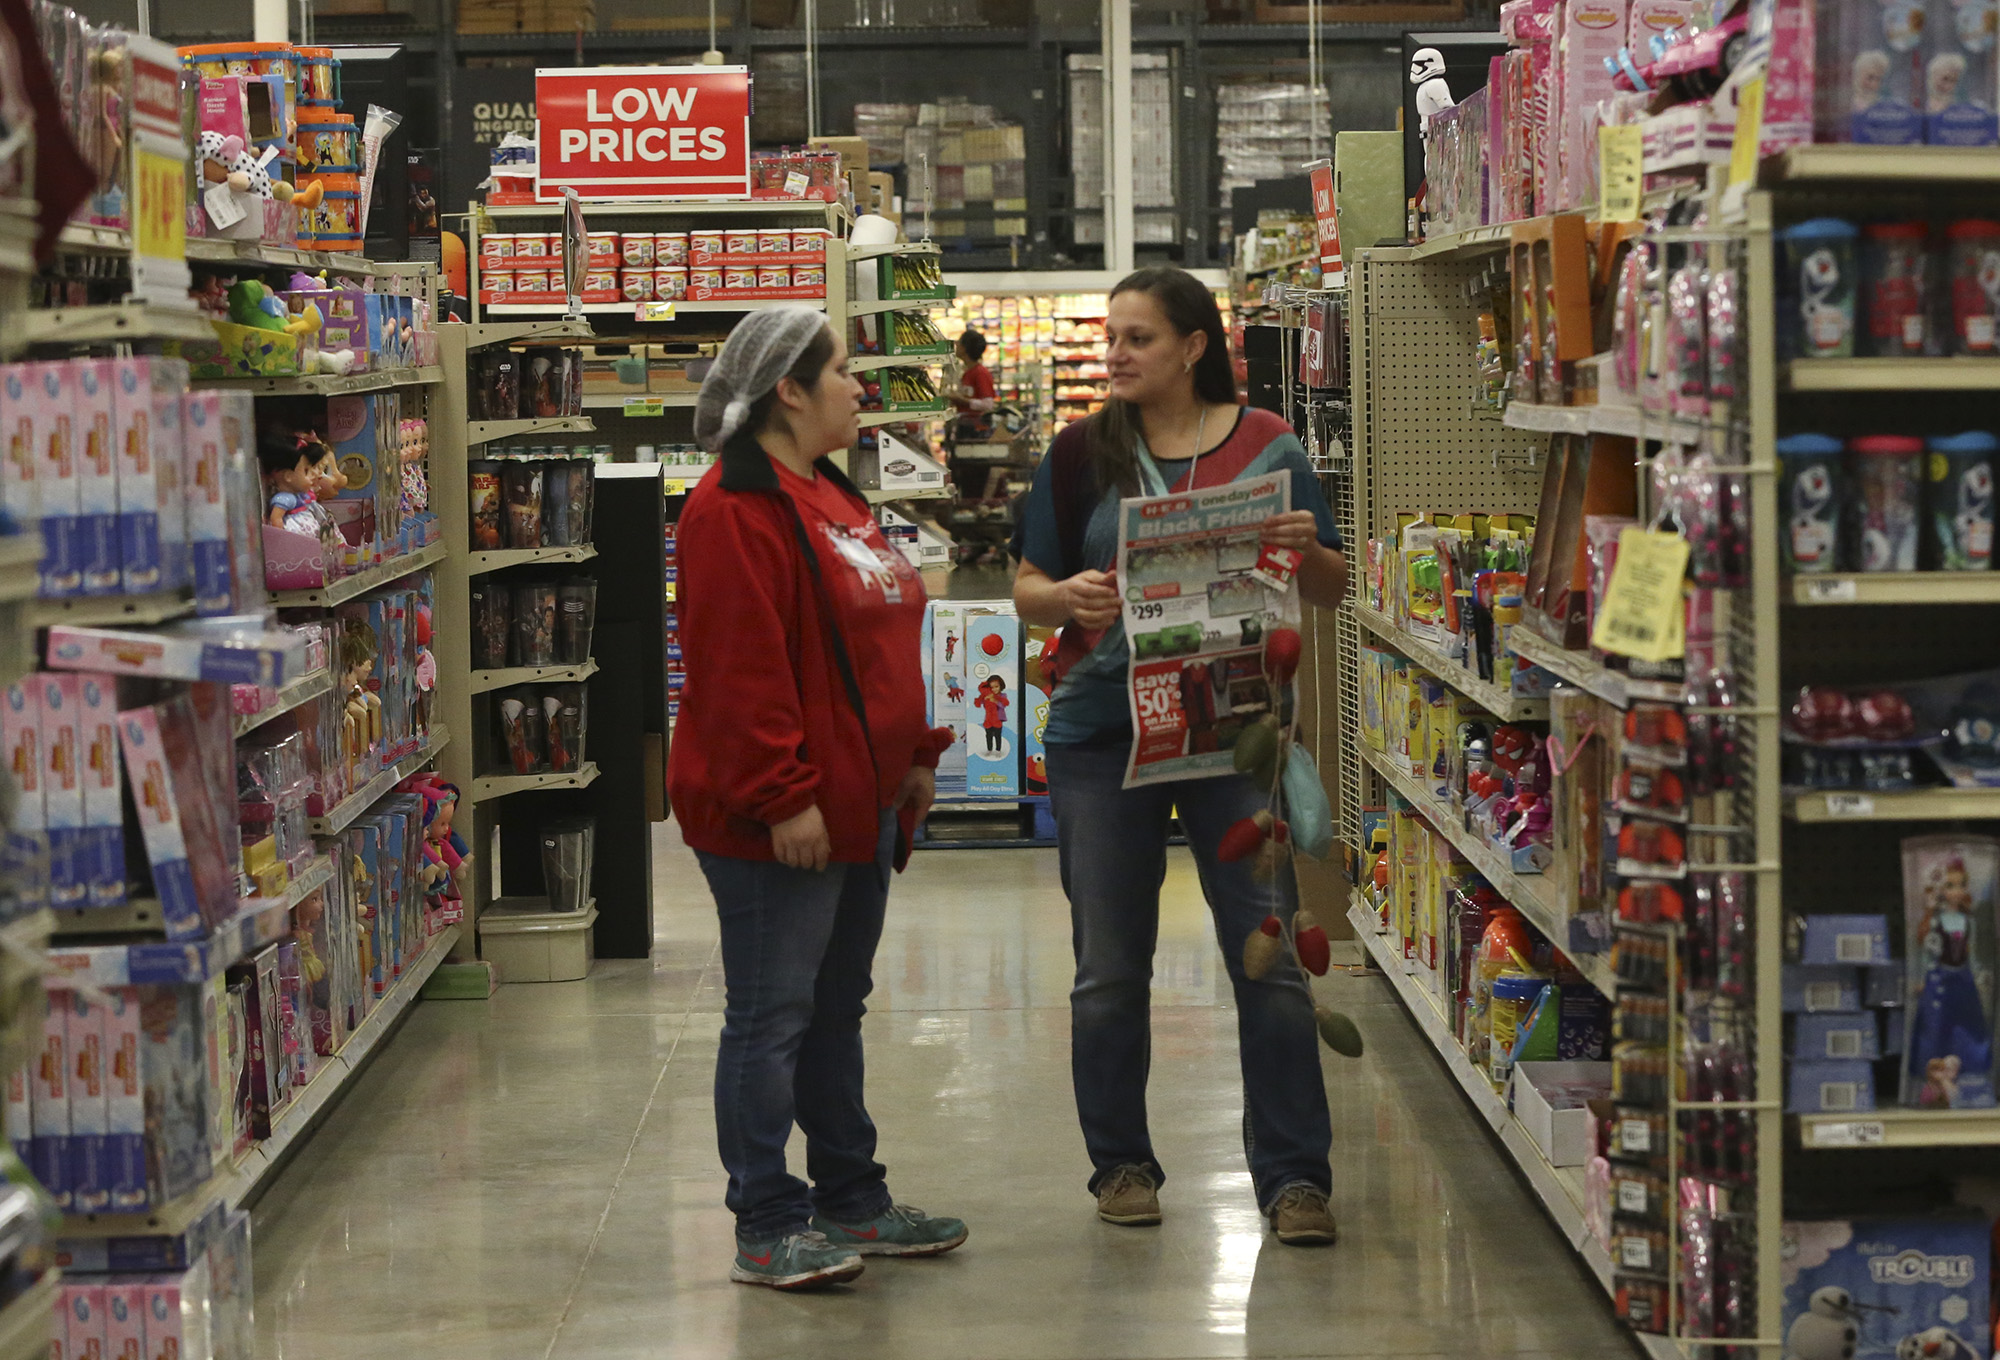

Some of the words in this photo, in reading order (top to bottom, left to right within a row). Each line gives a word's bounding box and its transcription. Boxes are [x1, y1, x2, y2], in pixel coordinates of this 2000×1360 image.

[586, 87, 699, 122] LOW
[560, 126, 727, 163] PRICES
[1316, 189, 1330, 213] LOW
[1317, 217, 1337, 242] PRICES
[1138, 517, 1200, 537] Black
[1206, 504, 1276, 529] Friday
[1131, 602, 1163, 620] $299
[1135, 671, 1180, 690] save
[1137, 685, 1182, 717] 50%
[1159, 711, 1182, 723] ALL
[1872, 1254, 1971, 1281] TROUBLE
